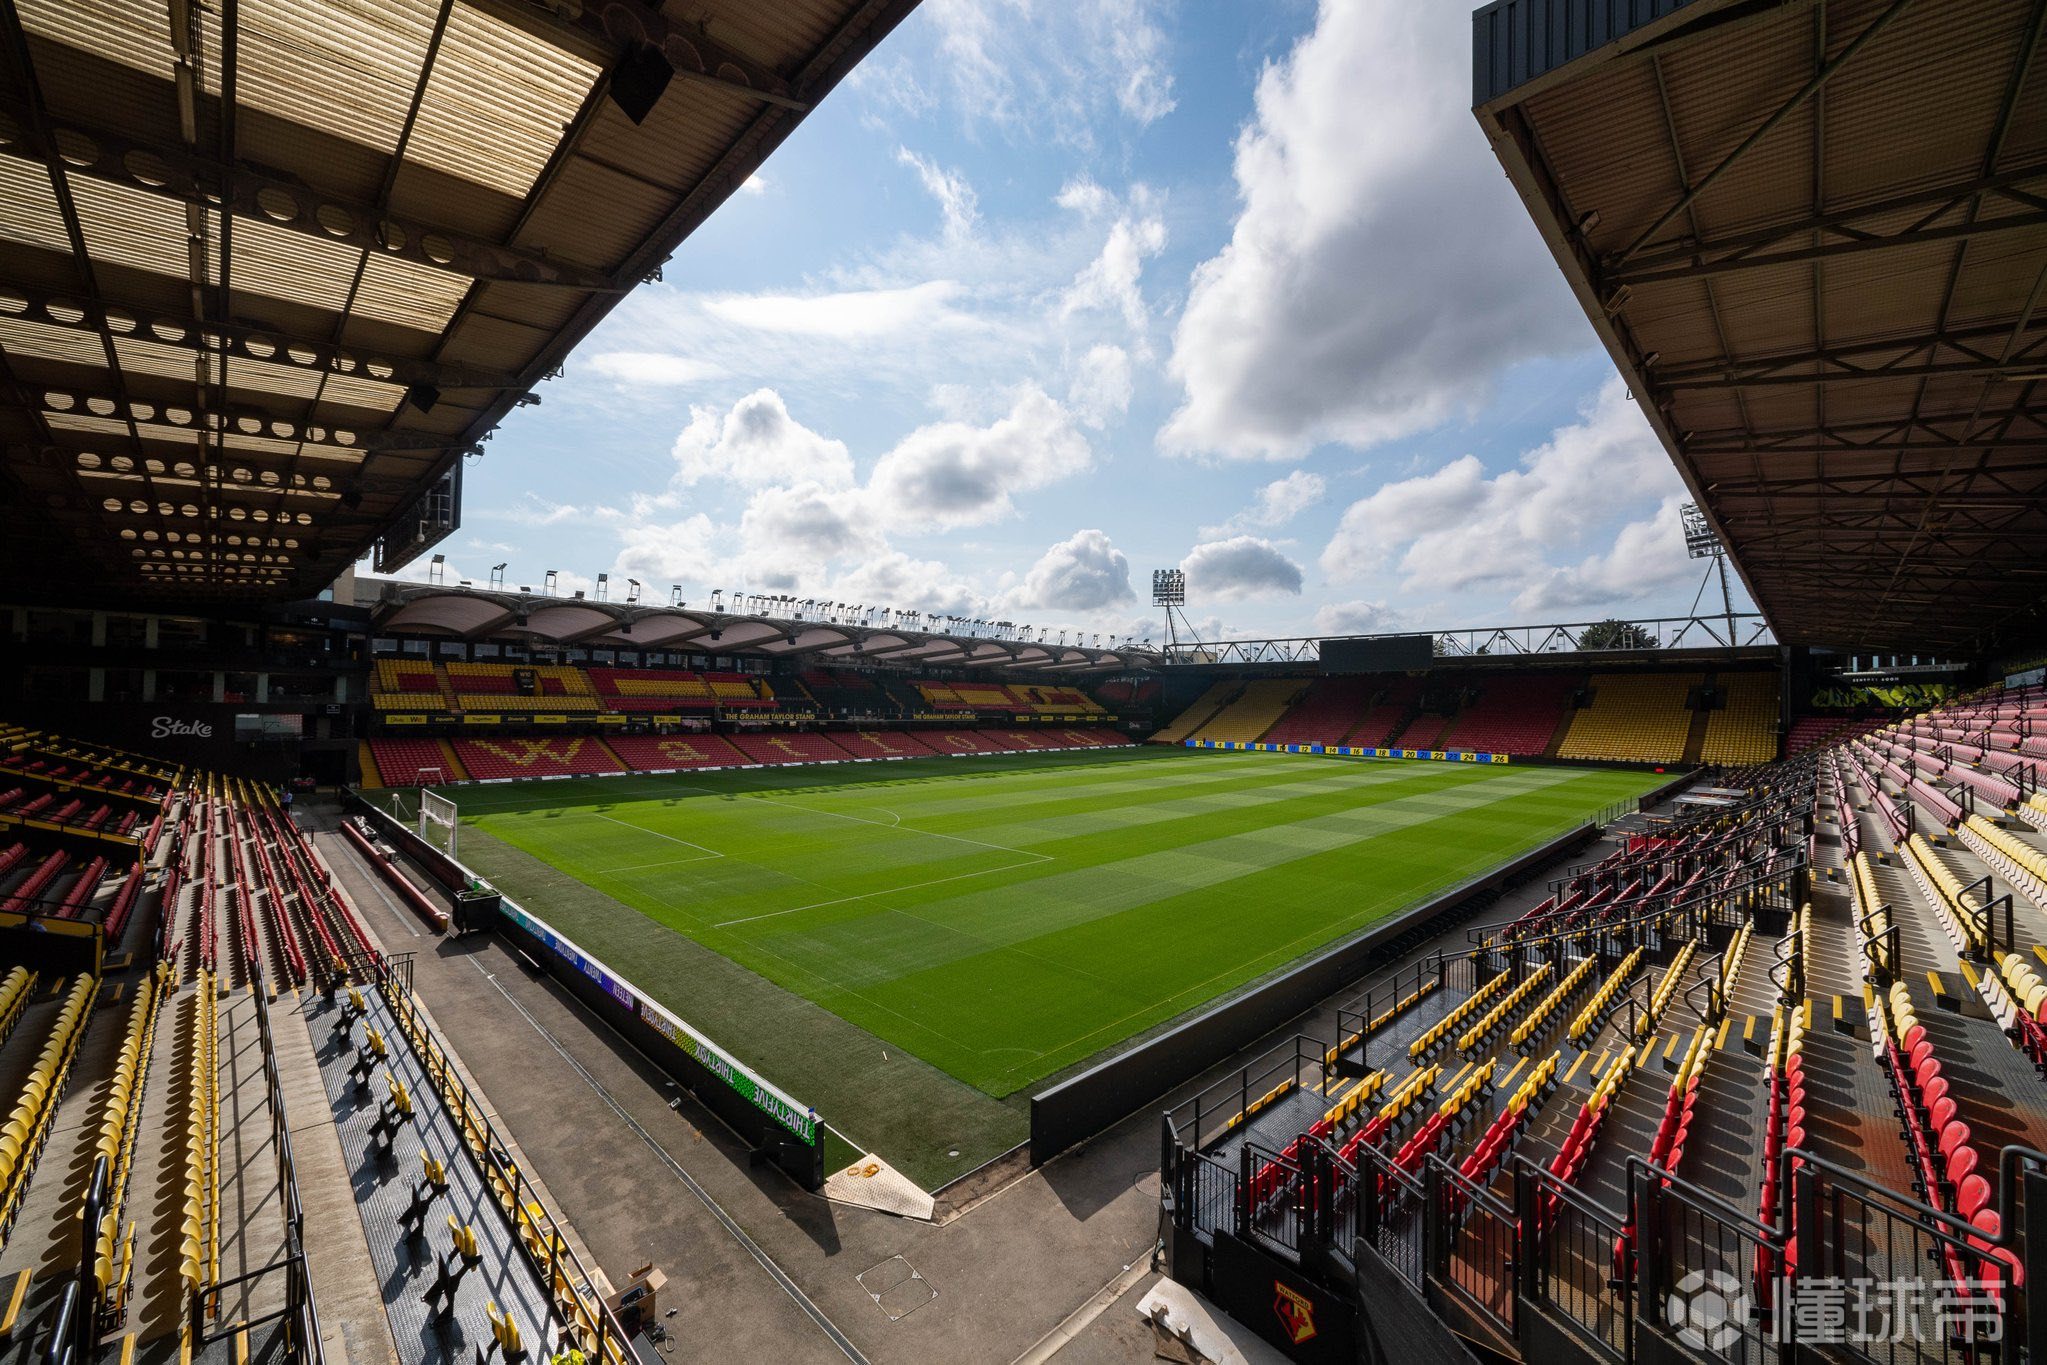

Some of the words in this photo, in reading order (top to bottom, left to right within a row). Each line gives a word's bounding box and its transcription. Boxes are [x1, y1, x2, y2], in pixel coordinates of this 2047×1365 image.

[152, 716, 212, 738] Stake
[1434, 752, 1443, 760] 22
[1448, 753, 1458, 761] 23
[1479, 754, 1488, 762] 25
[1494, 755, 1505, 763] 26
[695, 1042, 734, 1084] THIRTYSIX
[753, 1084, 810, 1140] THIRTYFIVE
